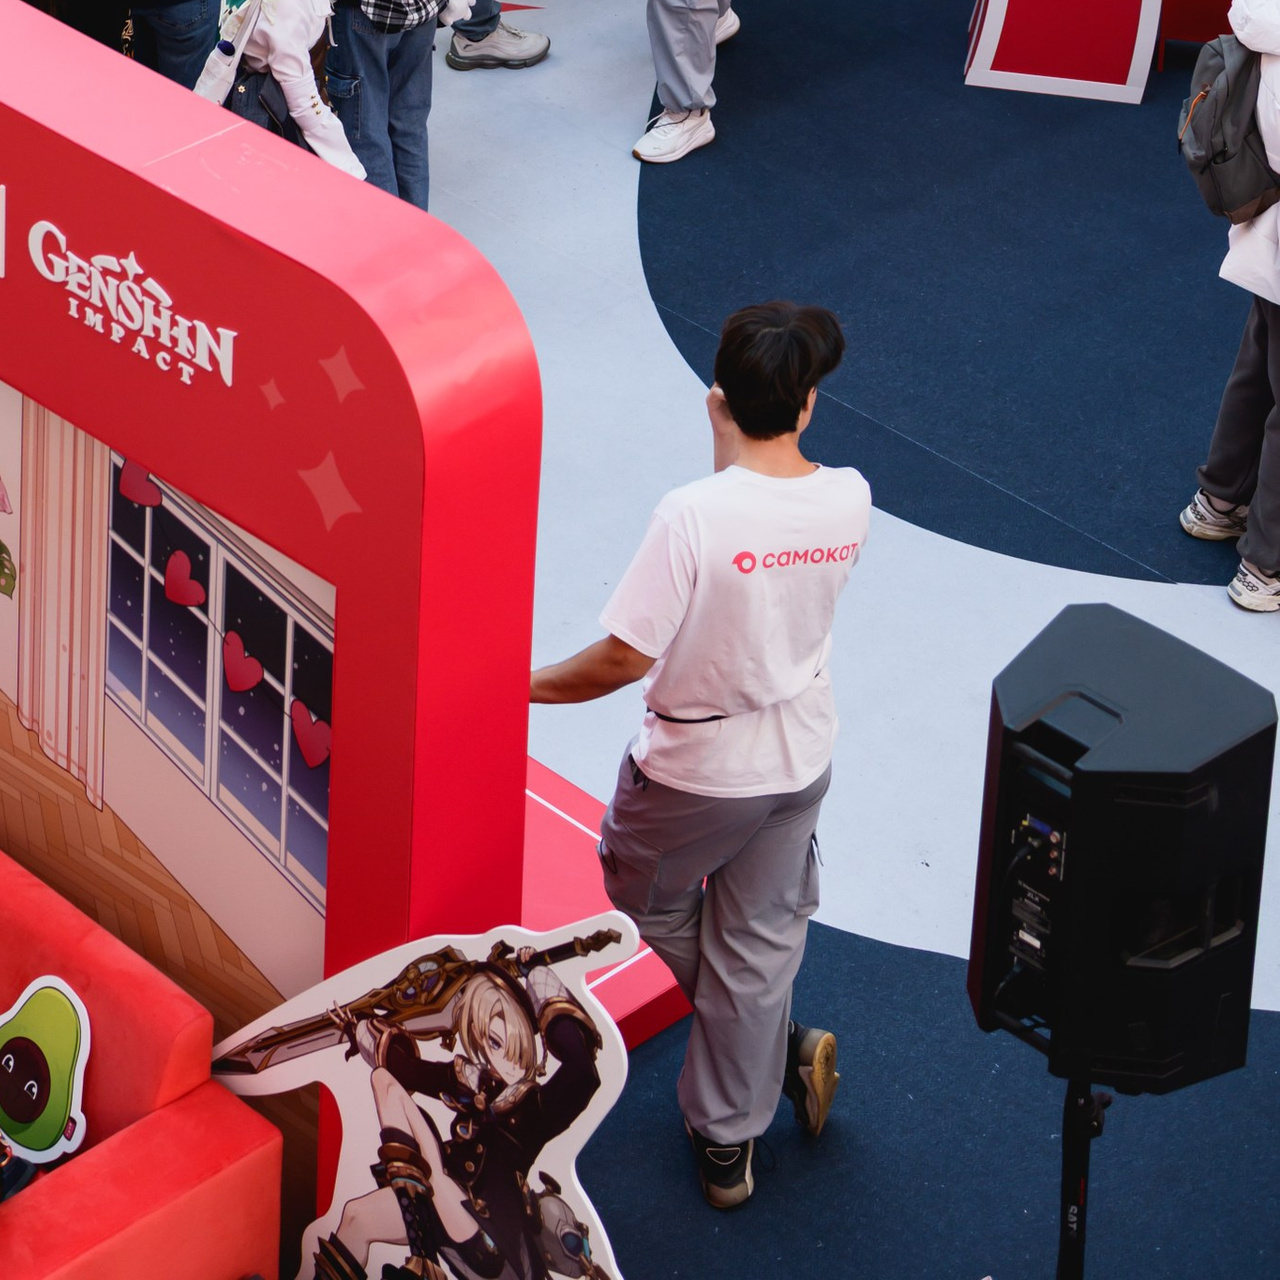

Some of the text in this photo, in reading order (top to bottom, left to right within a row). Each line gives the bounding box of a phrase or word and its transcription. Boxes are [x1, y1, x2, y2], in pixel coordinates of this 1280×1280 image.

[27, 220, 239, 387] GENSHIN
[67, 296, 196, 386] IMPACT
[761, 542, 859, 569] самокат
